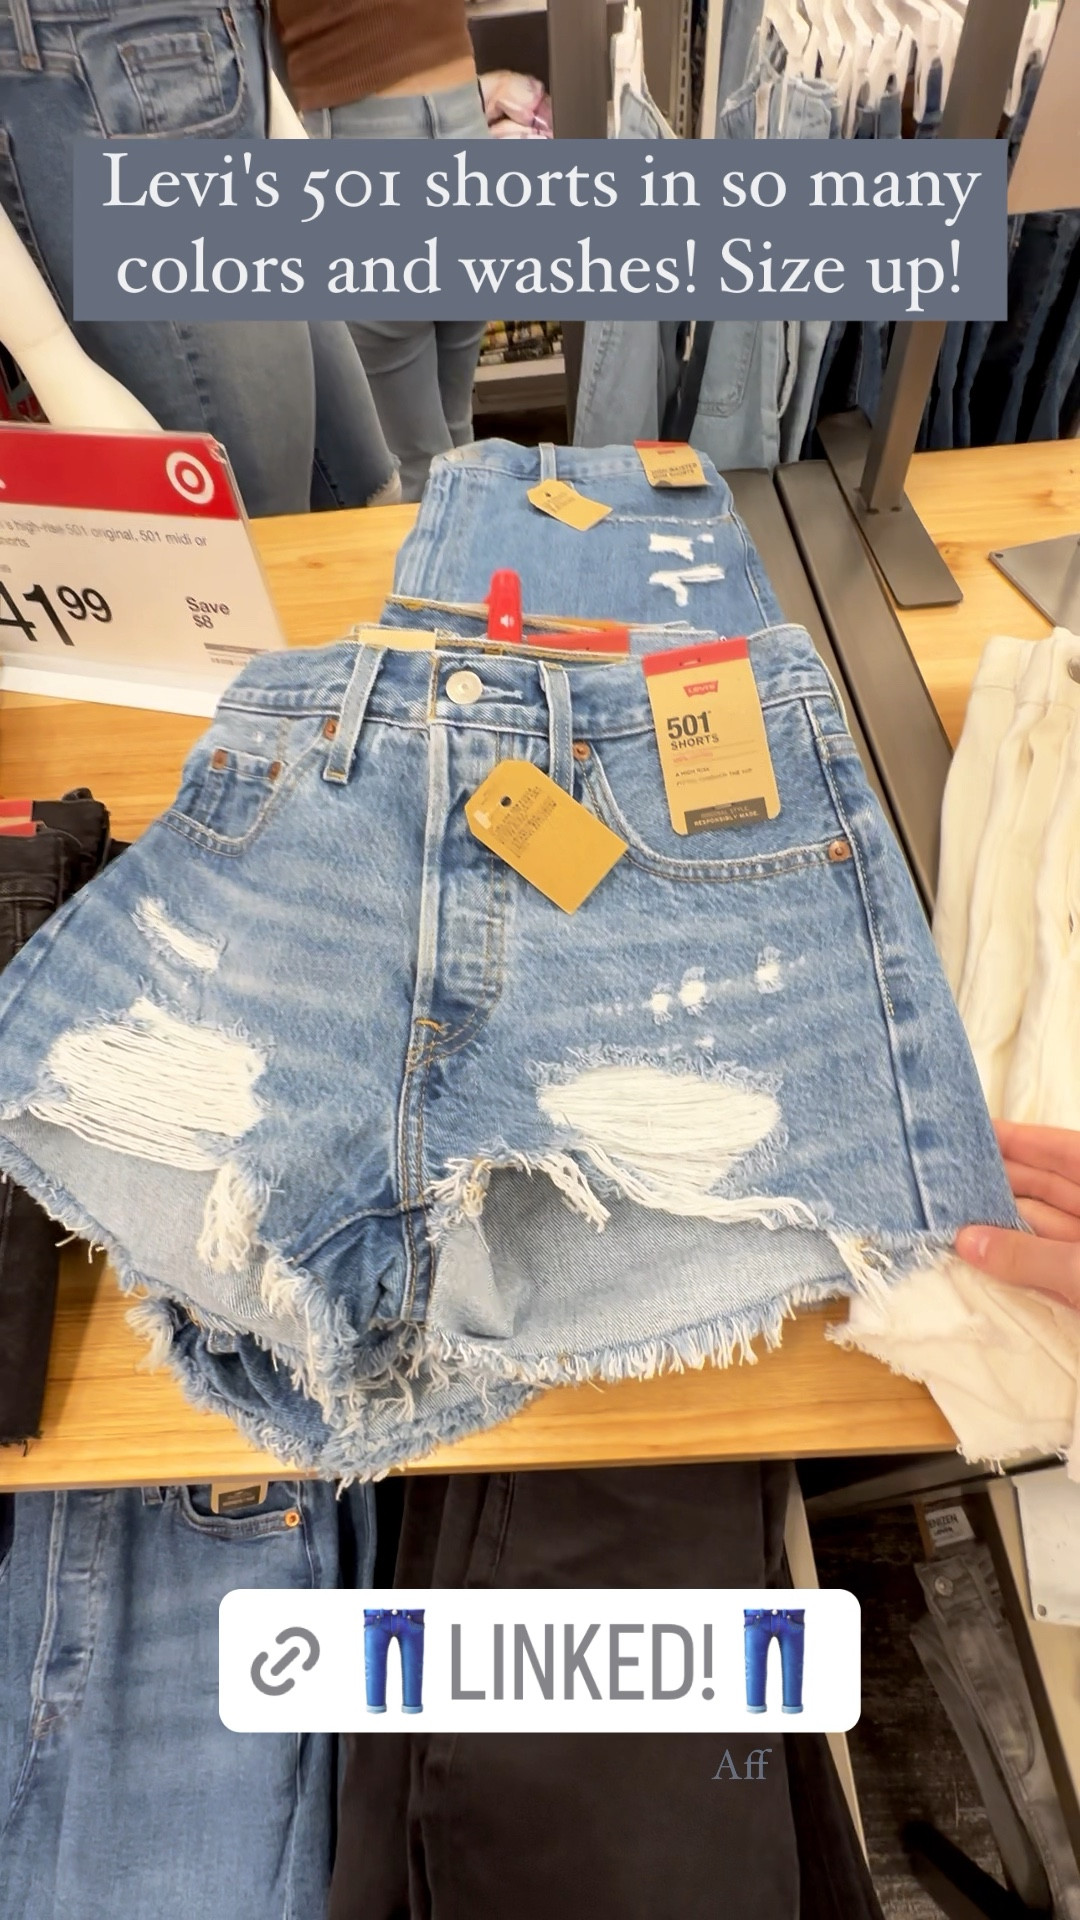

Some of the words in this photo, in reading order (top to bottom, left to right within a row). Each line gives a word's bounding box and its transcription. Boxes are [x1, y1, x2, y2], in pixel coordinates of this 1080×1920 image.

[64, 523, 88, 536] 501
[139, 529, 162, 543] 501
[165, 531, 193, 545] midi
[195, 536, 208, 547] or
[185, 596, 231, 616] Save
[192, 614, 214, 629] $8
[670, 733, 720, 751] SHORTS
